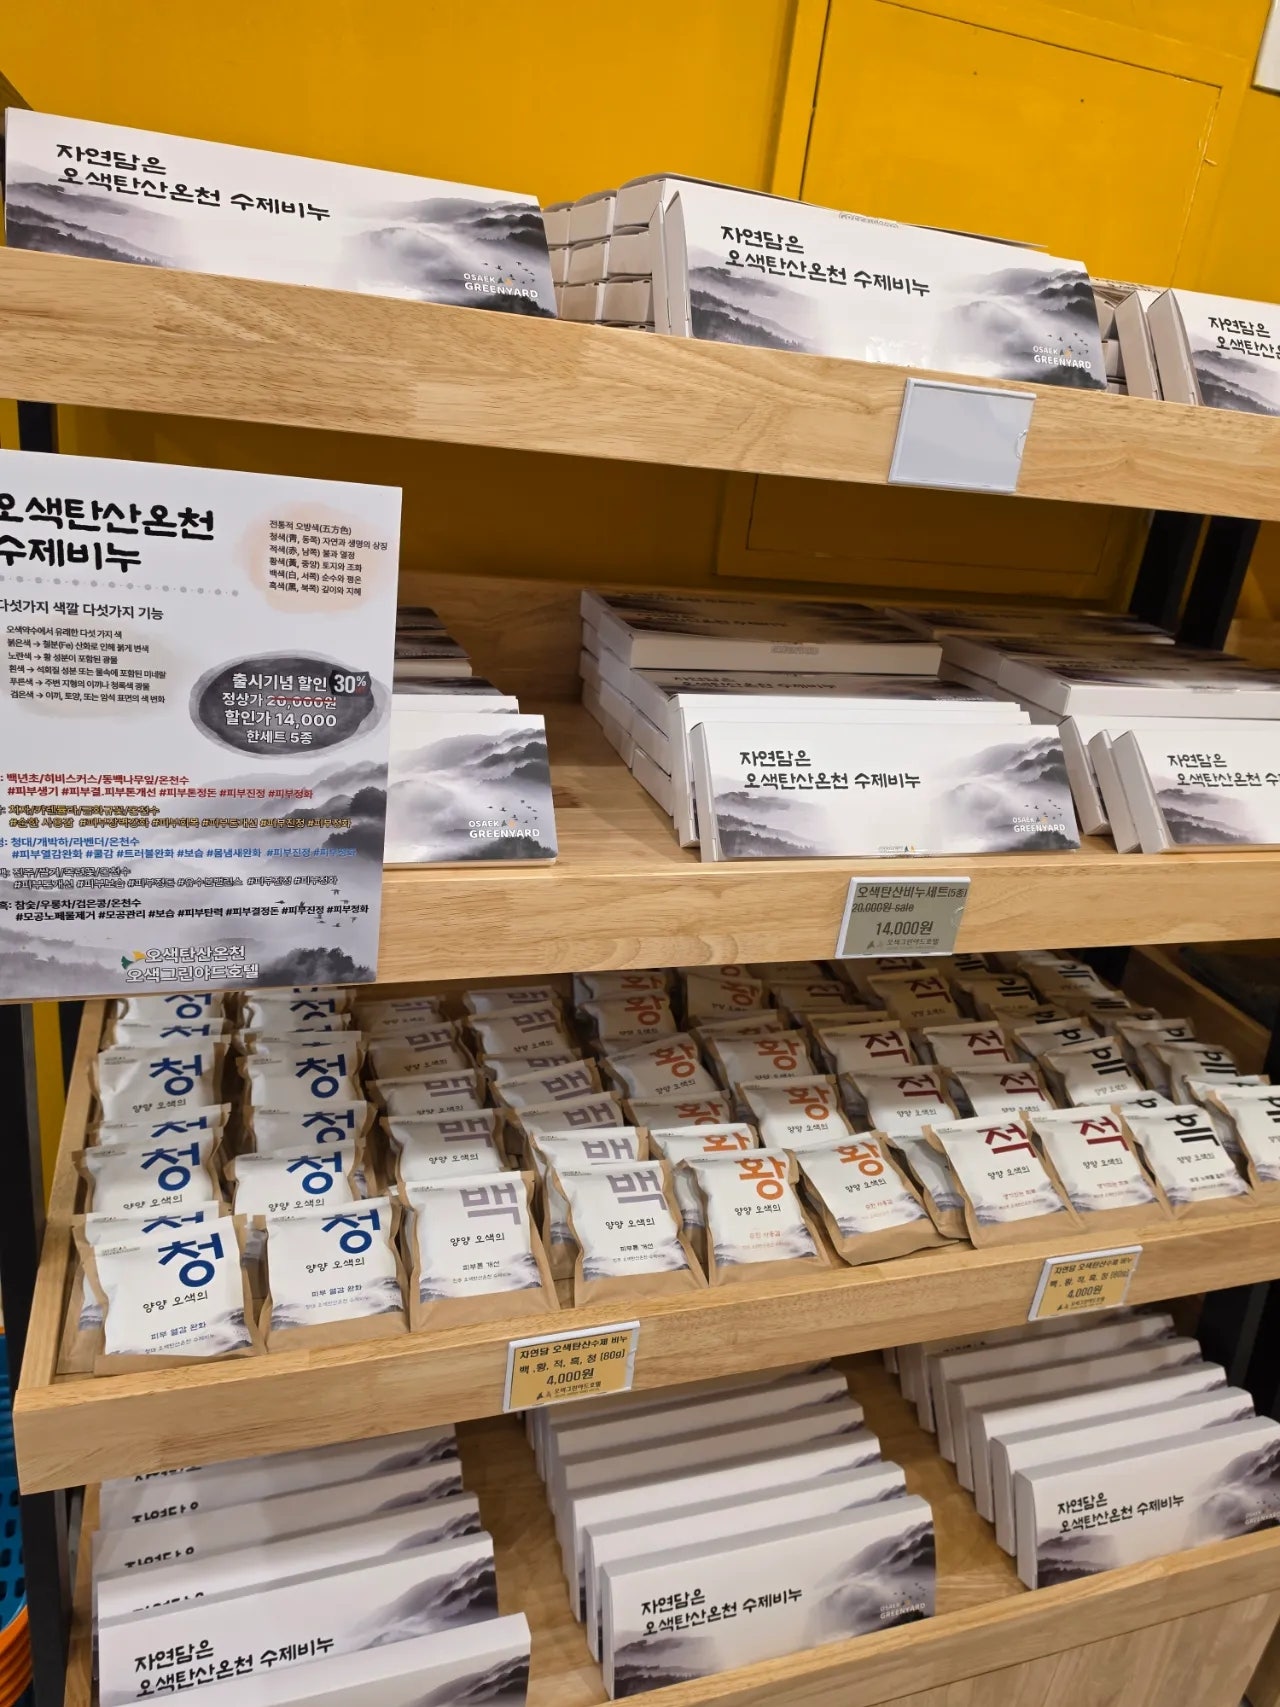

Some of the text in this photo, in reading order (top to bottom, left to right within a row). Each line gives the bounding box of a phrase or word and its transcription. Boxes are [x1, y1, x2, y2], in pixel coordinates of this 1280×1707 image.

[56, 144, 167, 175] 자연담은
[57, 167, 331, 222] 오색탄산온천 수제비누
[720, 225, 805, 254] 자연담은
[463, 272, 496, 283] OSAEK
[724, 249, 931, 297] 오색탄산온천 수제비누
[464, 282, 538, 298] GREENYARD
[1207, 316, 1271, 339] 자연담은
[1032, 345, 1059, 355] OSAEK
[1033, 354, 1092, 369] GREENYARD
[0, 492, 214, 541] 오색탄산온천
[269, 520, 294, 530] 전통적
[302, 535, 388, 551] 동쪽) 자연과 생명의 상징
[0, 534, 142, 573] 수제비누
[302, 547, 320, 558] 남쪽)
[322, 549, 338, 559] 불과
[340, 551, 355, 560] 열정
[301, 559, 362, 573] 중앙) 토지와 조화
[321, 573, 345, 584] 순수와
[321, 585, 344, 595] 깊이와
[346, 587, 362, 596] 지혜
[53, 602, 79, 616] 색깔
[83, 603, 134, 619] 다섯가지
[138, 607, 164, 621] 기능
[6, 625, 122, 640] 오색약수에서 유래한 다섯 가지 색
[232, 673, 327, 693] 출시기념 할인
[333, 673, 367, 694] 30%
[222, 692, 263, 707] 정상가
[224, 709, 337, 730] 할인가 14,000
[246, 729, 313, 745] 한세트 5종
[739, 749, 812, 767] 자연담은
[1167, 753, 1227, 768] 자연담은
[744, 772, 921, 790] 오색탄산온천 수제비누
[1177, 772, 1262, 787] 오색탄산온천
[7, 786, 59, 797] #피부생기
[219, 788, 266, 798] #피부진정
[268, 789, 314, 799] #피부정화
[468, 820, 499, 828] OSAEK
[1012, 816, 1036, 824] OSAEK
[1013, 823, 1066, 833] GREENYARD
[10, 837, 140, 848] 청대/개박하/라벤더/온천수
[469, 828, 540, 839] GREENYARD
[11, 849, 83, 860] #피부열감완화
[116, 848, 174, 859] #트러블완화
[176, 848, 203, 858] #보습
[266, 848, 311, 858] #피부진정
[15, 898, 142, 910] 참숯/우롱차/검은콩/온천수
[16, 911, 96, 921] #모공노폐물제거
[98, 910, 146, 920] #모공관리
[148, 909, 175, 919] #보습
[177, 907, 223, 917] #피부탄력
[225, 906, 279, 917] #피부결정돈
[326, 904, 369, 914] #피부정화
[144, 945, 246, 964] 오색탄산온천
[125, 961, 260, 984] 오색그린야드호텔
[859, 1029, 911, 1064] 적
[149, 1054, 203, 1097] 청
[295, 1053, 347, 1098] 청
[784, 1085, 831, 1122] 황
[1071, 1116, 1130, 1152] 적
[1165, 1113, 1221, 1147] 흑
[976, 1122, 1038, 1159] 적
[140, 1141, 200, 1192] 청
[429, 1152, 479, 1165] 양양 오색의
[835, 1141, 885, 1177] 황
[1082, 1157, 1124, 1169] 양양 오색의
[286, 1151, 343, 1195] 청
[734, 1156, 787, 1201] 황
[987, 1165, 1031, 1180] 양양 오색의
[605, 1169, 668, 1211] 백
[845, 1178, 887, 1193] 양양 오색의
[123, 1194, 183, 1211] 양양 오색의
[268, 1198, 325, 1213] 양양 오색의
[459, 1182, 522, 1226] 백
[735, 1203, 781, 1217] 양양 오색의
[320, 1208, 381, 1254] 청
[605, 1217, 656, 1230] 양양 오색의
[450, 1232, 506, 1247] 양양 오색의
[157, 1232, 225, 1288] 청
[305, 1257, 365, 1275] 양양 오색의
[142, 1290, 209, 1313] 양양 오색의
[150, 1329, 168, 1341] 피부
[1057, 1492, 1108, 1515] 자연담은
[1059, 1494, 1185, 1534] 오색탄산온천 수제비누
[641, 1588, 706, 1616] 자연담은
[879, 1602, 926, 1620] GREENYARD
[642, 1588, 803, 1637] 오색탄산온천 수제비누
[134, 1639, 214, 1673] 자연담은
[136, 1637, 335, 1698] 오색탄산온천 수제비누
